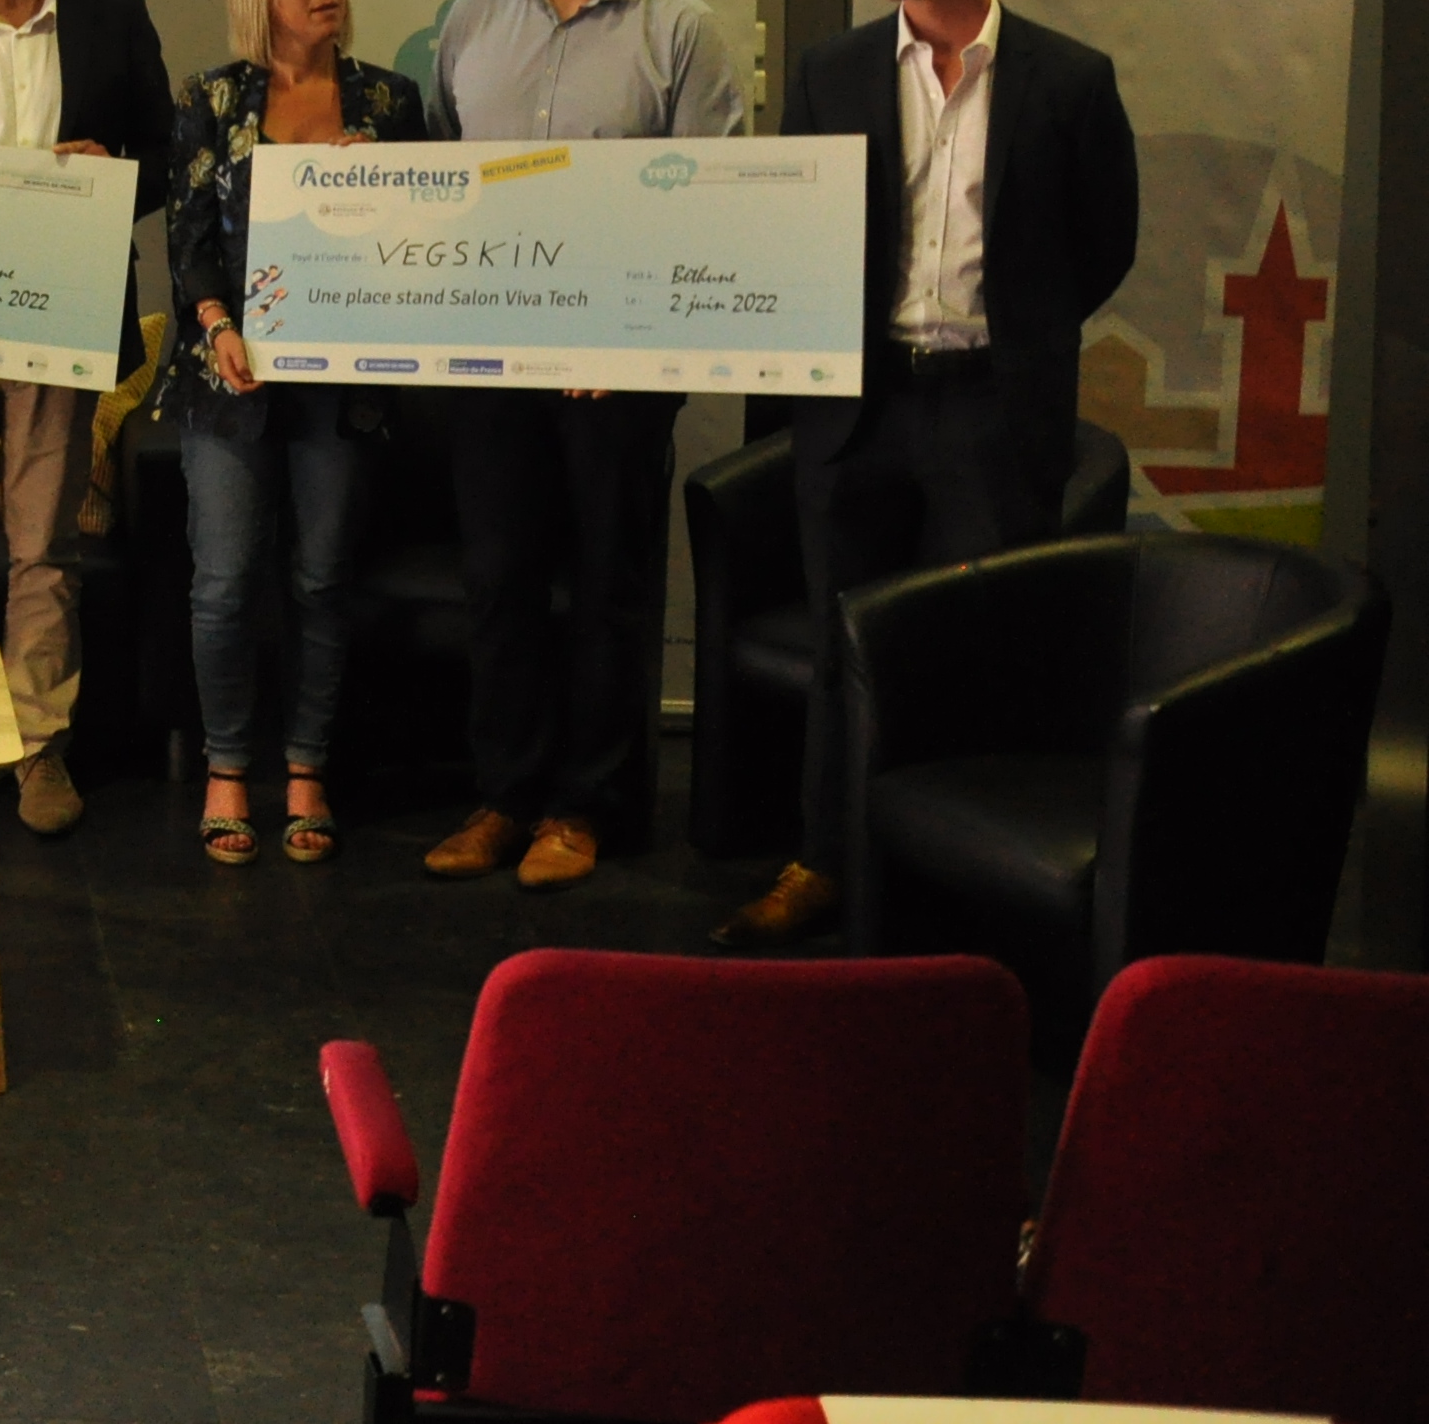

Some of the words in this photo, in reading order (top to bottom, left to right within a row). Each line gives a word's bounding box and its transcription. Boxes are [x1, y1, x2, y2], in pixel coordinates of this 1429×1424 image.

[298, 163, 471, 189] Accélérateurs
[7, 289, 51, 312] 2022
[307, 288, 342, 305] Une
[345, 287, 392, 308] place
[395, 287, 445, 306] stand
[448, 288, 500, 307] Salon
[505, 289, 542, 307] Viva
[548, 289, 589, 308] Tech
[669, 293, 682, 313] 2
[685, 293, 726, 319] juin
[731, 292, 778, 314] 2022
